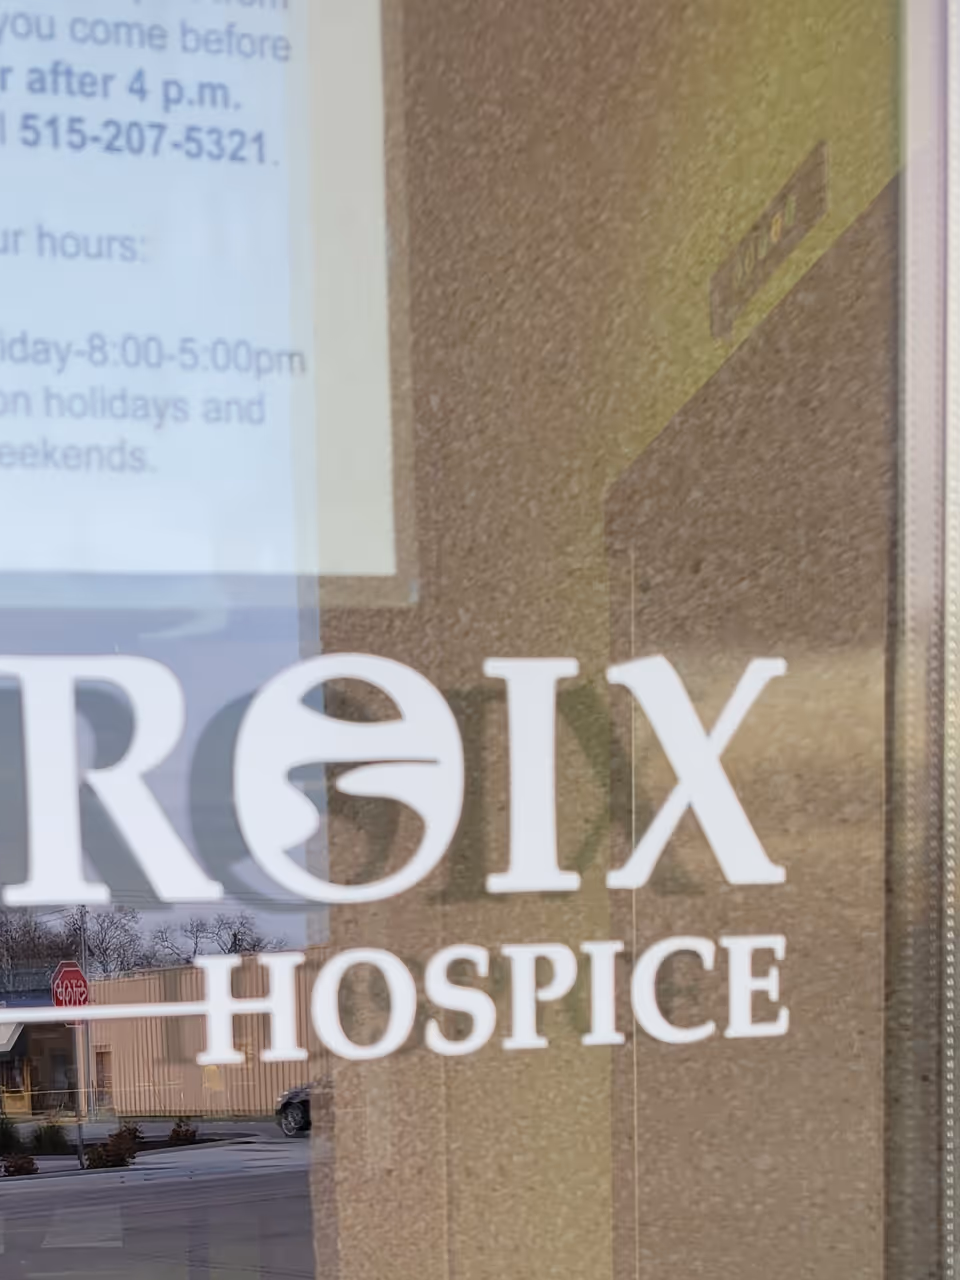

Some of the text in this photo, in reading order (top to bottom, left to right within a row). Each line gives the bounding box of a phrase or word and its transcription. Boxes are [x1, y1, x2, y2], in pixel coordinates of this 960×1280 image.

[69, 14, 168, 52] come
[180, 19, 291, 62] before
[27, 60, 116, 100] after
[128, 69, 149, 102] 4
[162, 77, 242, 113] p.m.
[19, 113, 281, 167] 515-207-5321.
[38, 223, 147, 264] hours:
[45, 386, 189, 430] holidays
[202, 392, 266, 426] and
[195, 934, 790, 1066] HOSPICE
